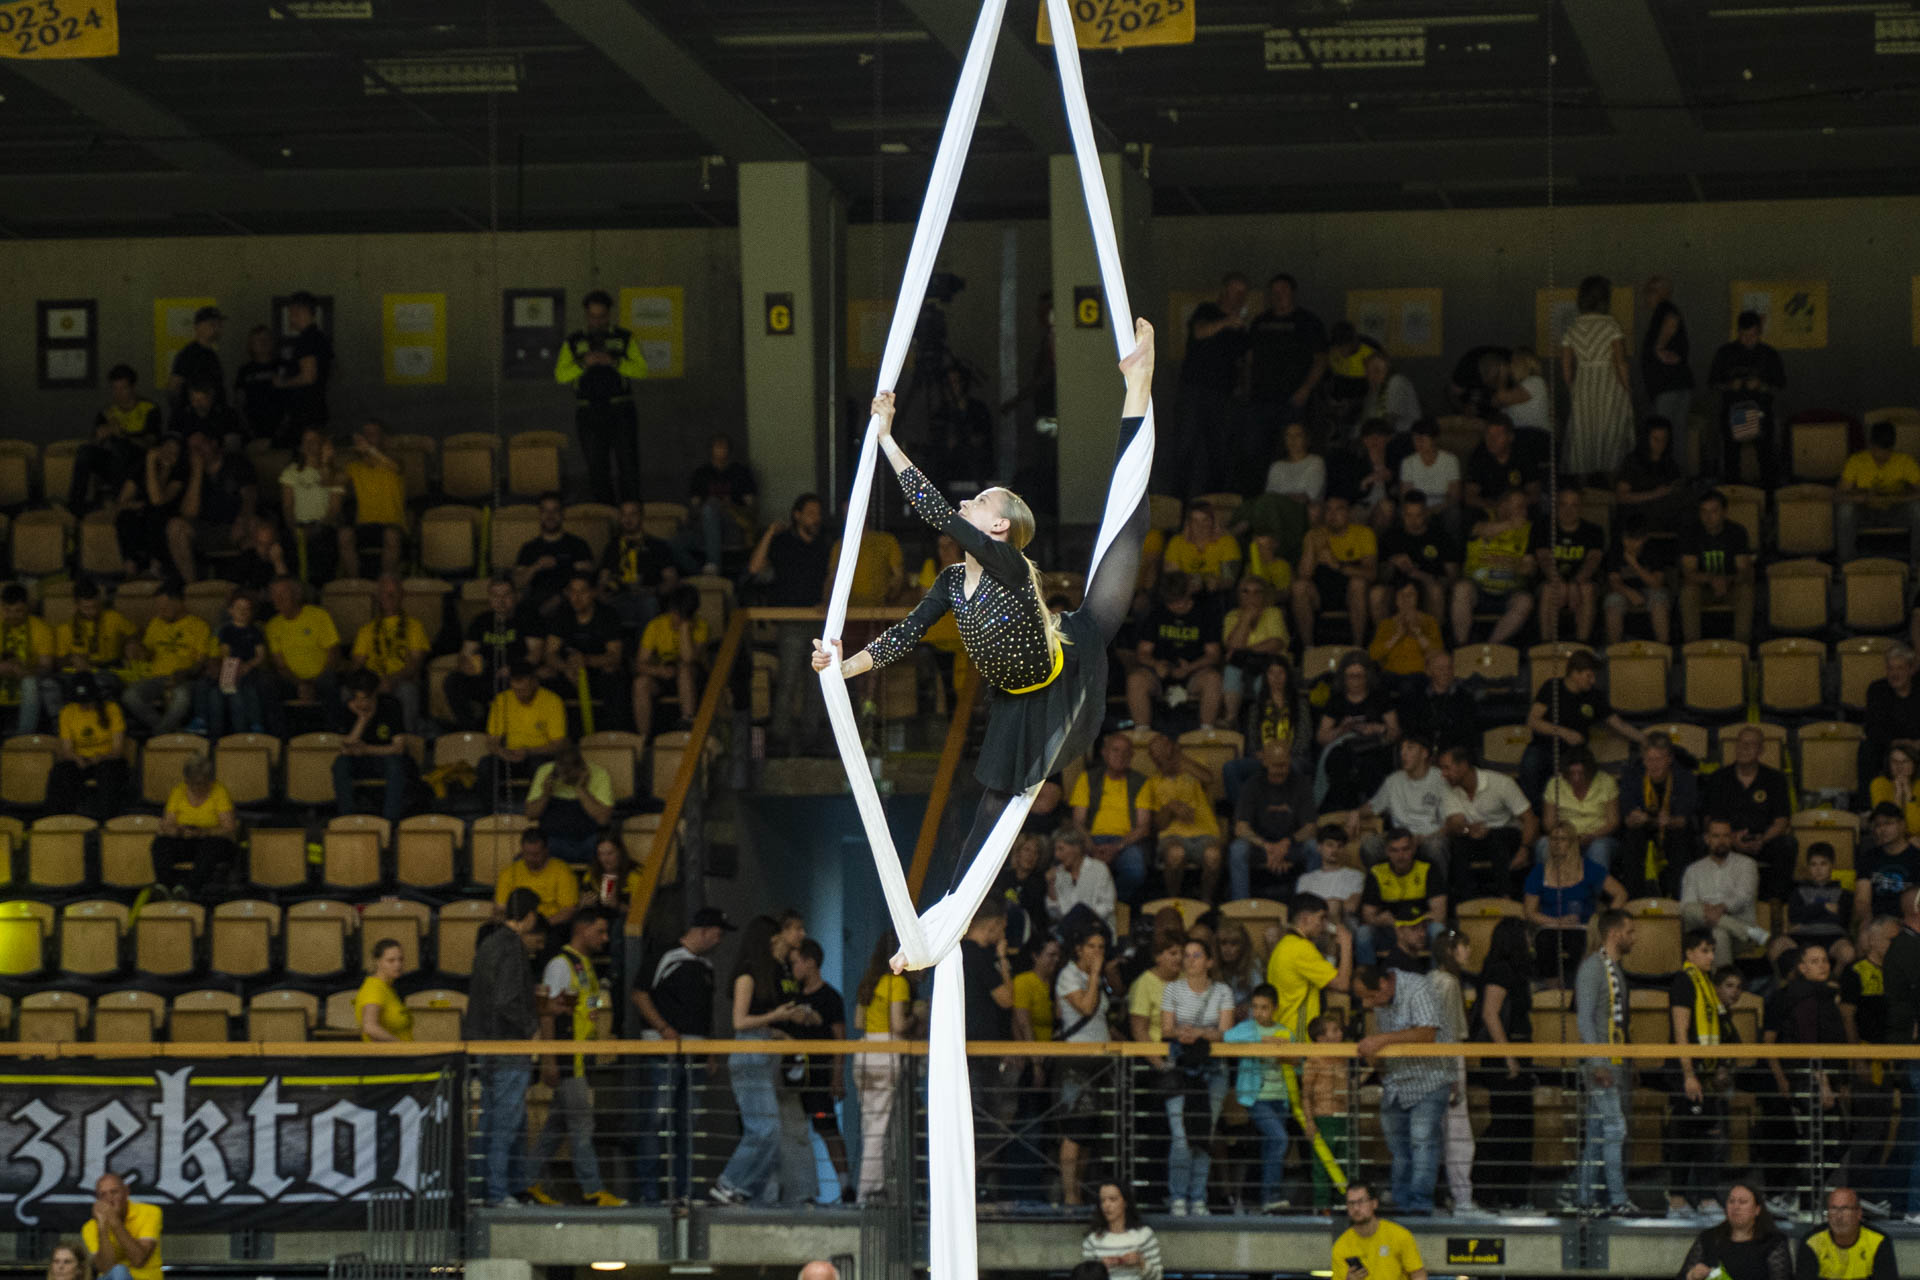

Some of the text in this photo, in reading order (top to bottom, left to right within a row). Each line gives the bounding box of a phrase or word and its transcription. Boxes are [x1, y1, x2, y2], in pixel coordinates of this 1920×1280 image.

[1075, 0, 1142, 22] 02
[1096, 0, 1186, 43] 2025
[15, 7, 103, 53] 2024
[769, 304, 790, 331] G
[1079, 297, 1099, 324] G
